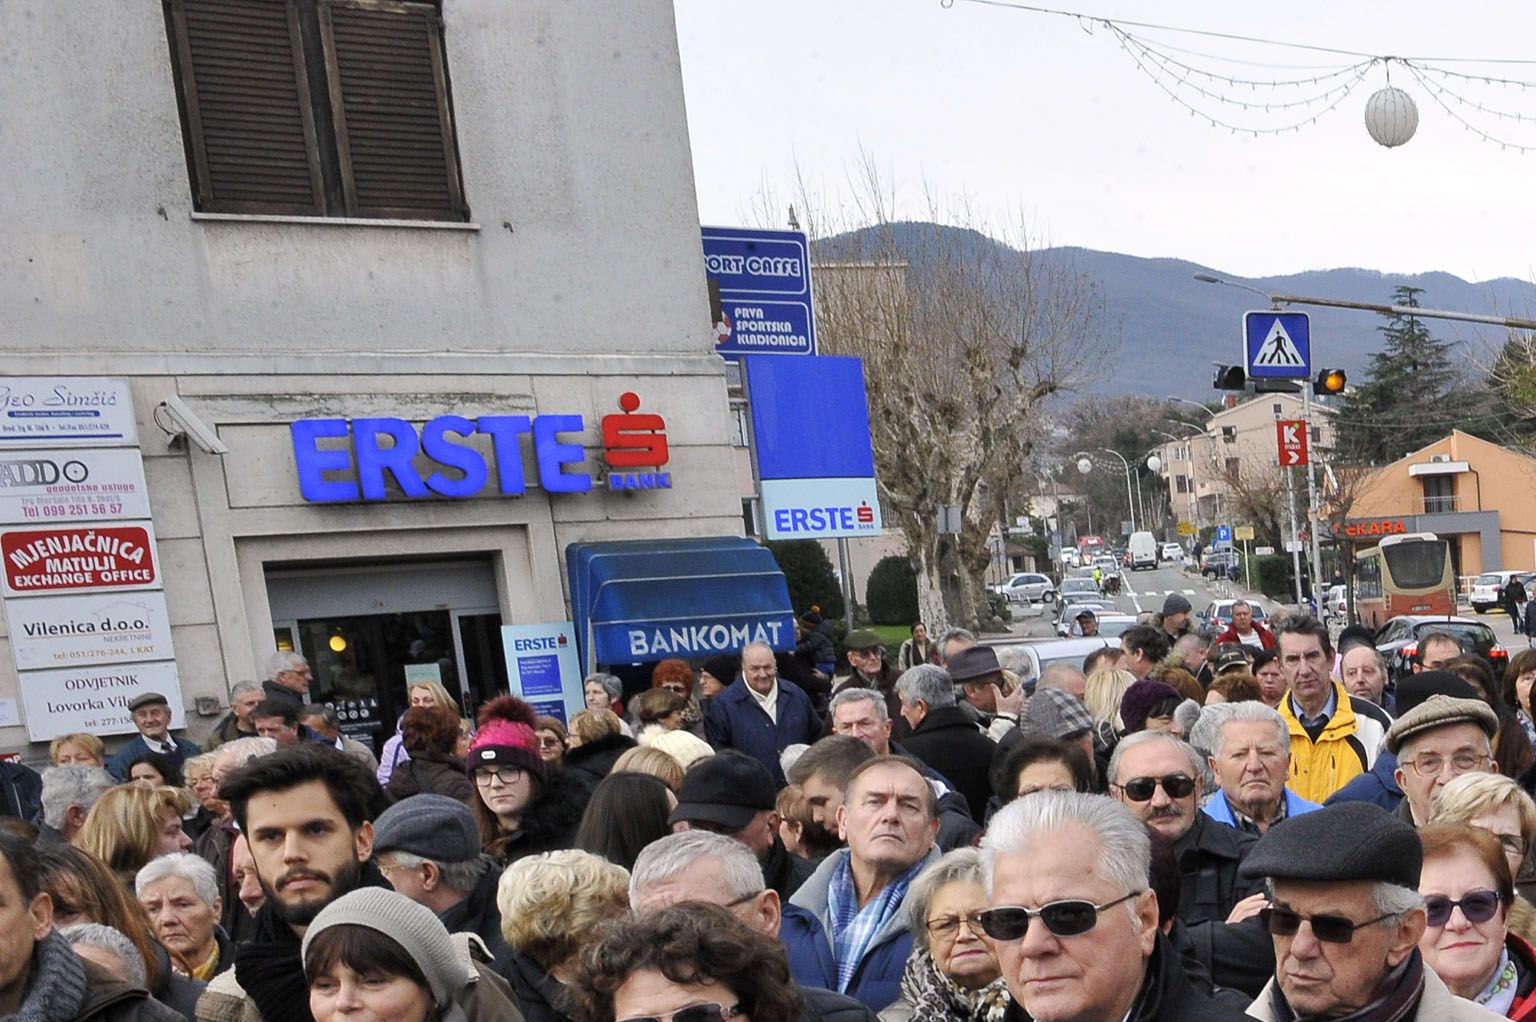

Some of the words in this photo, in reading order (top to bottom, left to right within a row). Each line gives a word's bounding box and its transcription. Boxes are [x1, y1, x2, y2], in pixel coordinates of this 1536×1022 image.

[746, 256, 801, 277] CAFFE
[734, 307, 764, 320] PRVA
[736, 320, 792, 333] SPORTSKA
[737, 333, 807, 347] KLADIONICA
[291, 414, 594, 501] ERSTE
[101, 482, 135, 493] usluge
[609, 471, 674, 490] BANK
[22, 506, 39, 517] Tel
[43, 505, 66, 517] 099
[69, 503, 88, 516] 251
[91, 503, 106, 514] 56
[110, 503, 123, 514] 57
[775, 507, 854, 533] ERSTE
[9, 531, 144, 570] MJENJAČNICA
[45, 556, 116, 573] MATULJI
[14, 572, 93, 587] EXCHANGE
[101, 569, 151, 582] OFFICE
[22, 621, 95, 636] Vilenica
[100, 617, 149, 632] d.o.o.
[514, 637, 557, 651] ERSTE
[628, 621, 782, 655] BANKOMAT
[65, 674, 140, 691] ODVJETNIK
[47, 699, 105, 714] Lovorka
